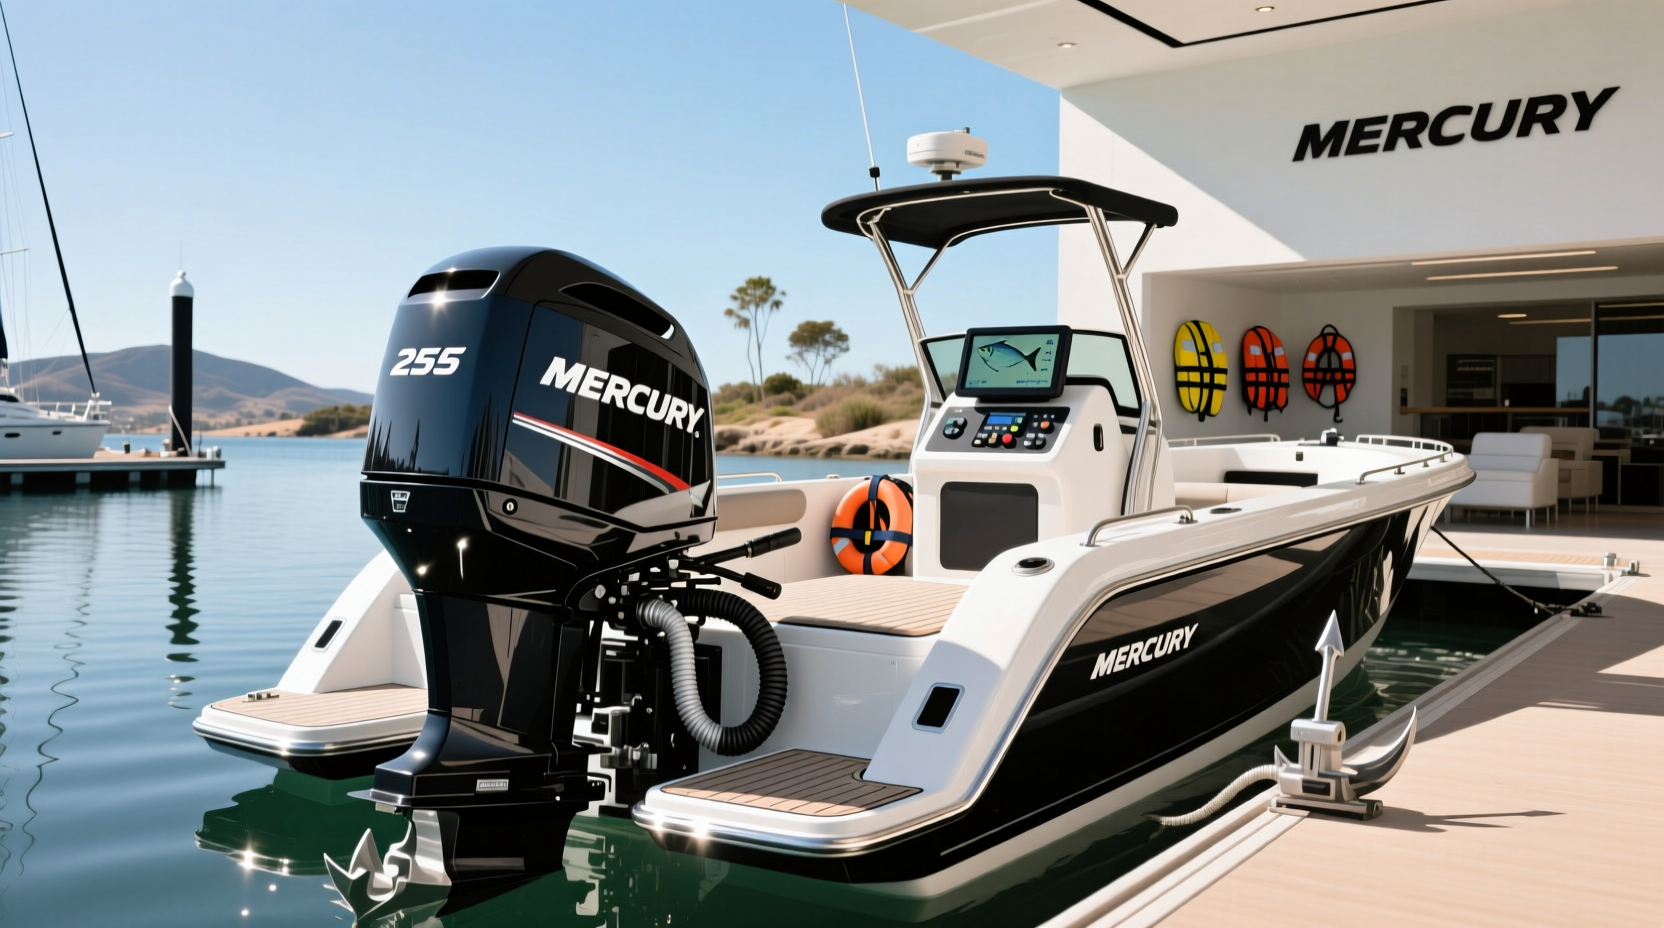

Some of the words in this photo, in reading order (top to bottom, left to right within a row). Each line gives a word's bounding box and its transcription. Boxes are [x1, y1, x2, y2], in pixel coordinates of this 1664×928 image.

[1292, 86, 1620, 162] MERCURY
[390, 346, 467, 377] 255
[1091, 623, 1198, 680] MERCURY
